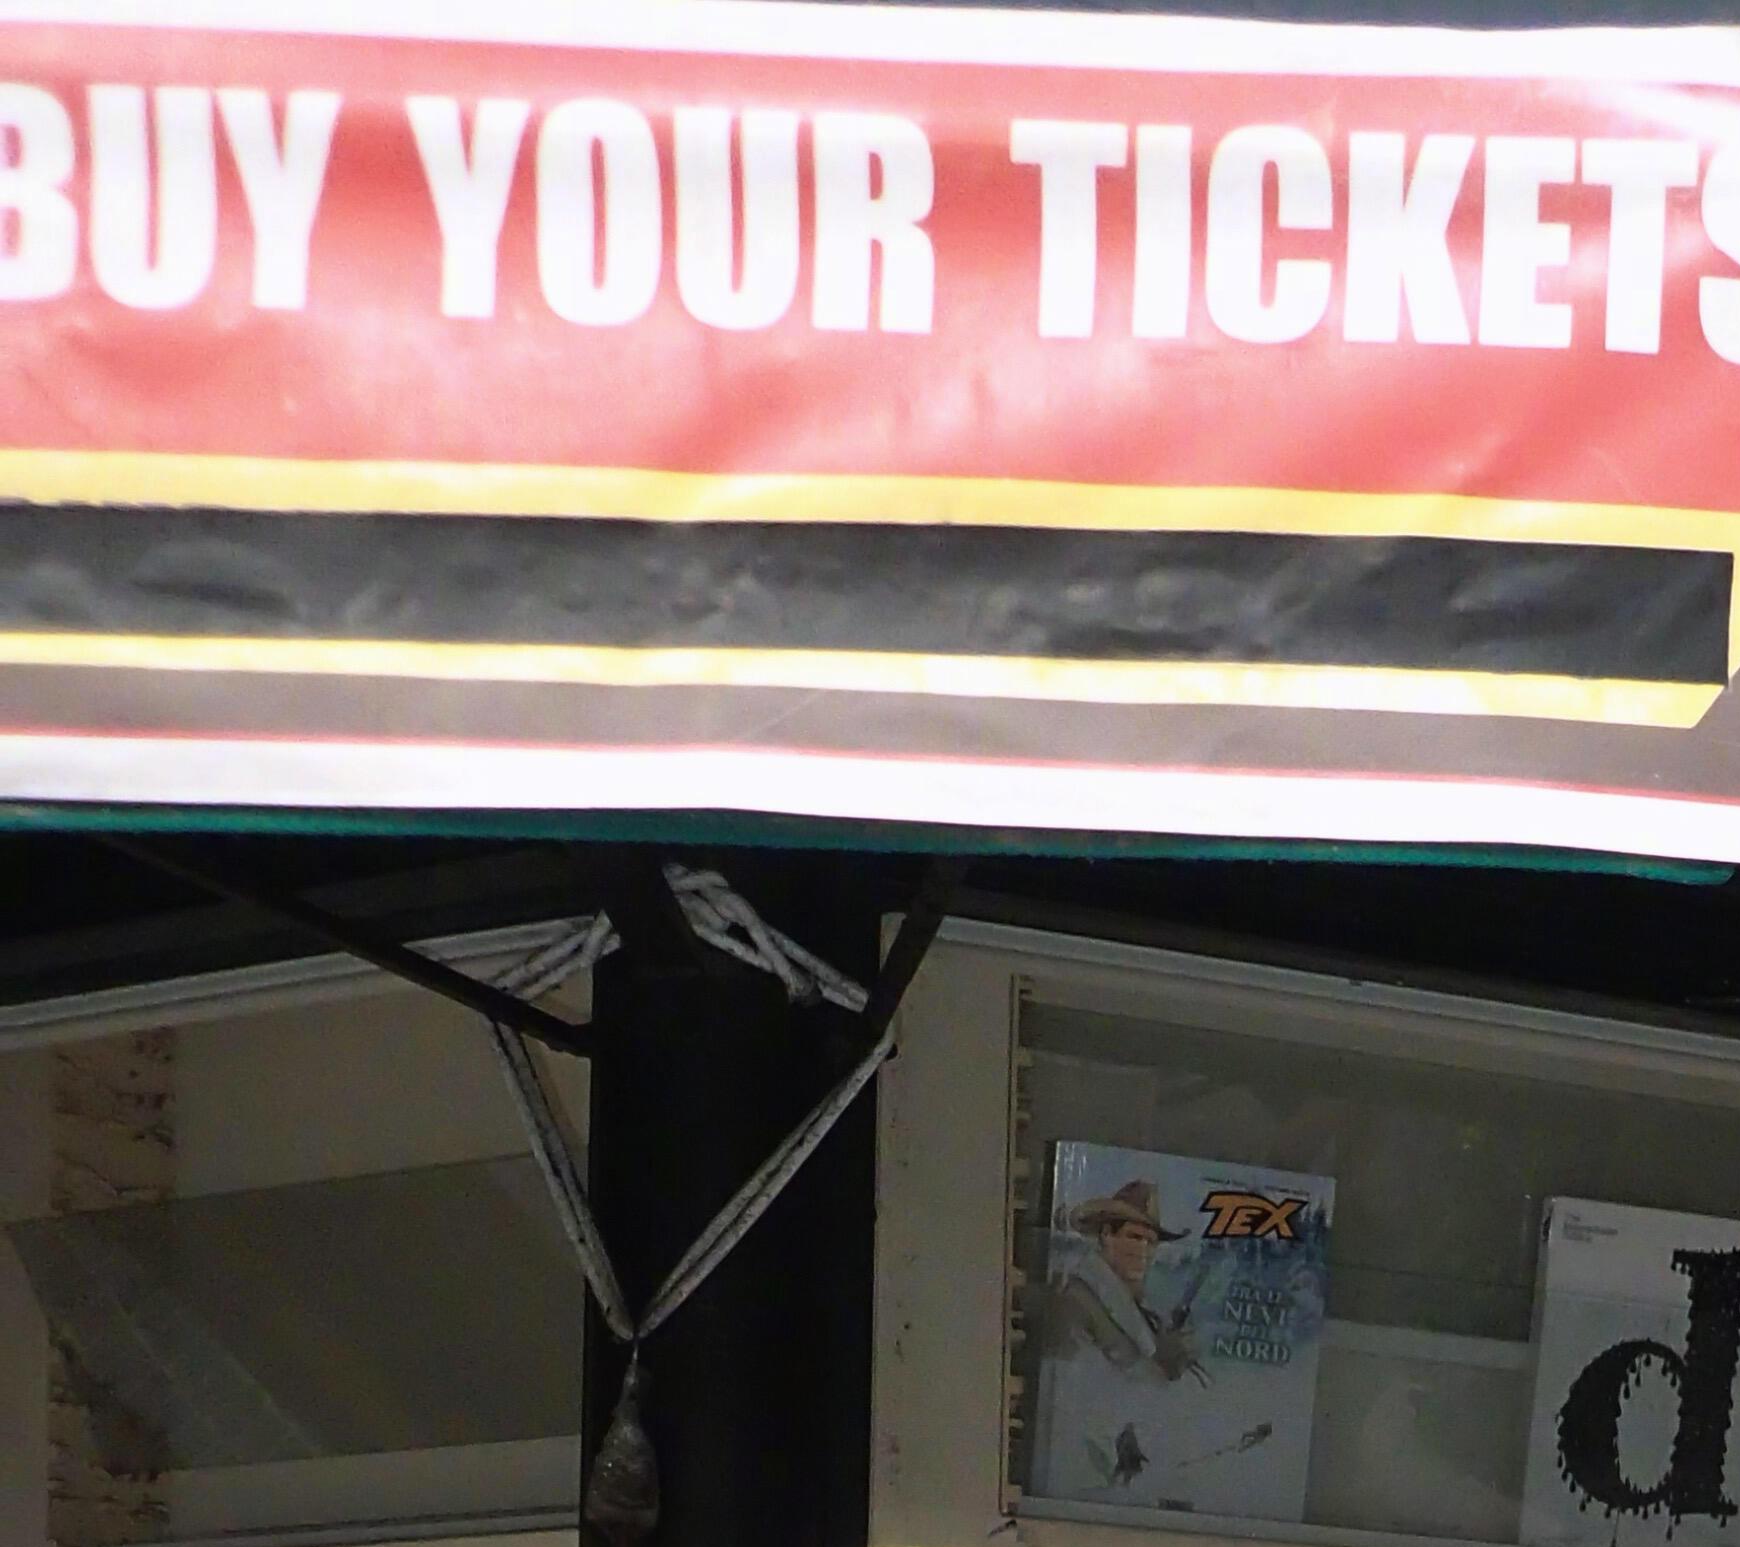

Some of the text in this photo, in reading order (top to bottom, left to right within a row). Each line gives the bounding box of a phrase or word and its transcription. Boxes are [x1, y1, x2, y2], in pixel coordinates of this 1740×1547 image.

[0, 85, 335, 312] BUY
[407, 97, 936, 335] YOUR
[1200, 1191, 1308, 1240] TEX
[1215, 1337, 1291, 1364] NORD
